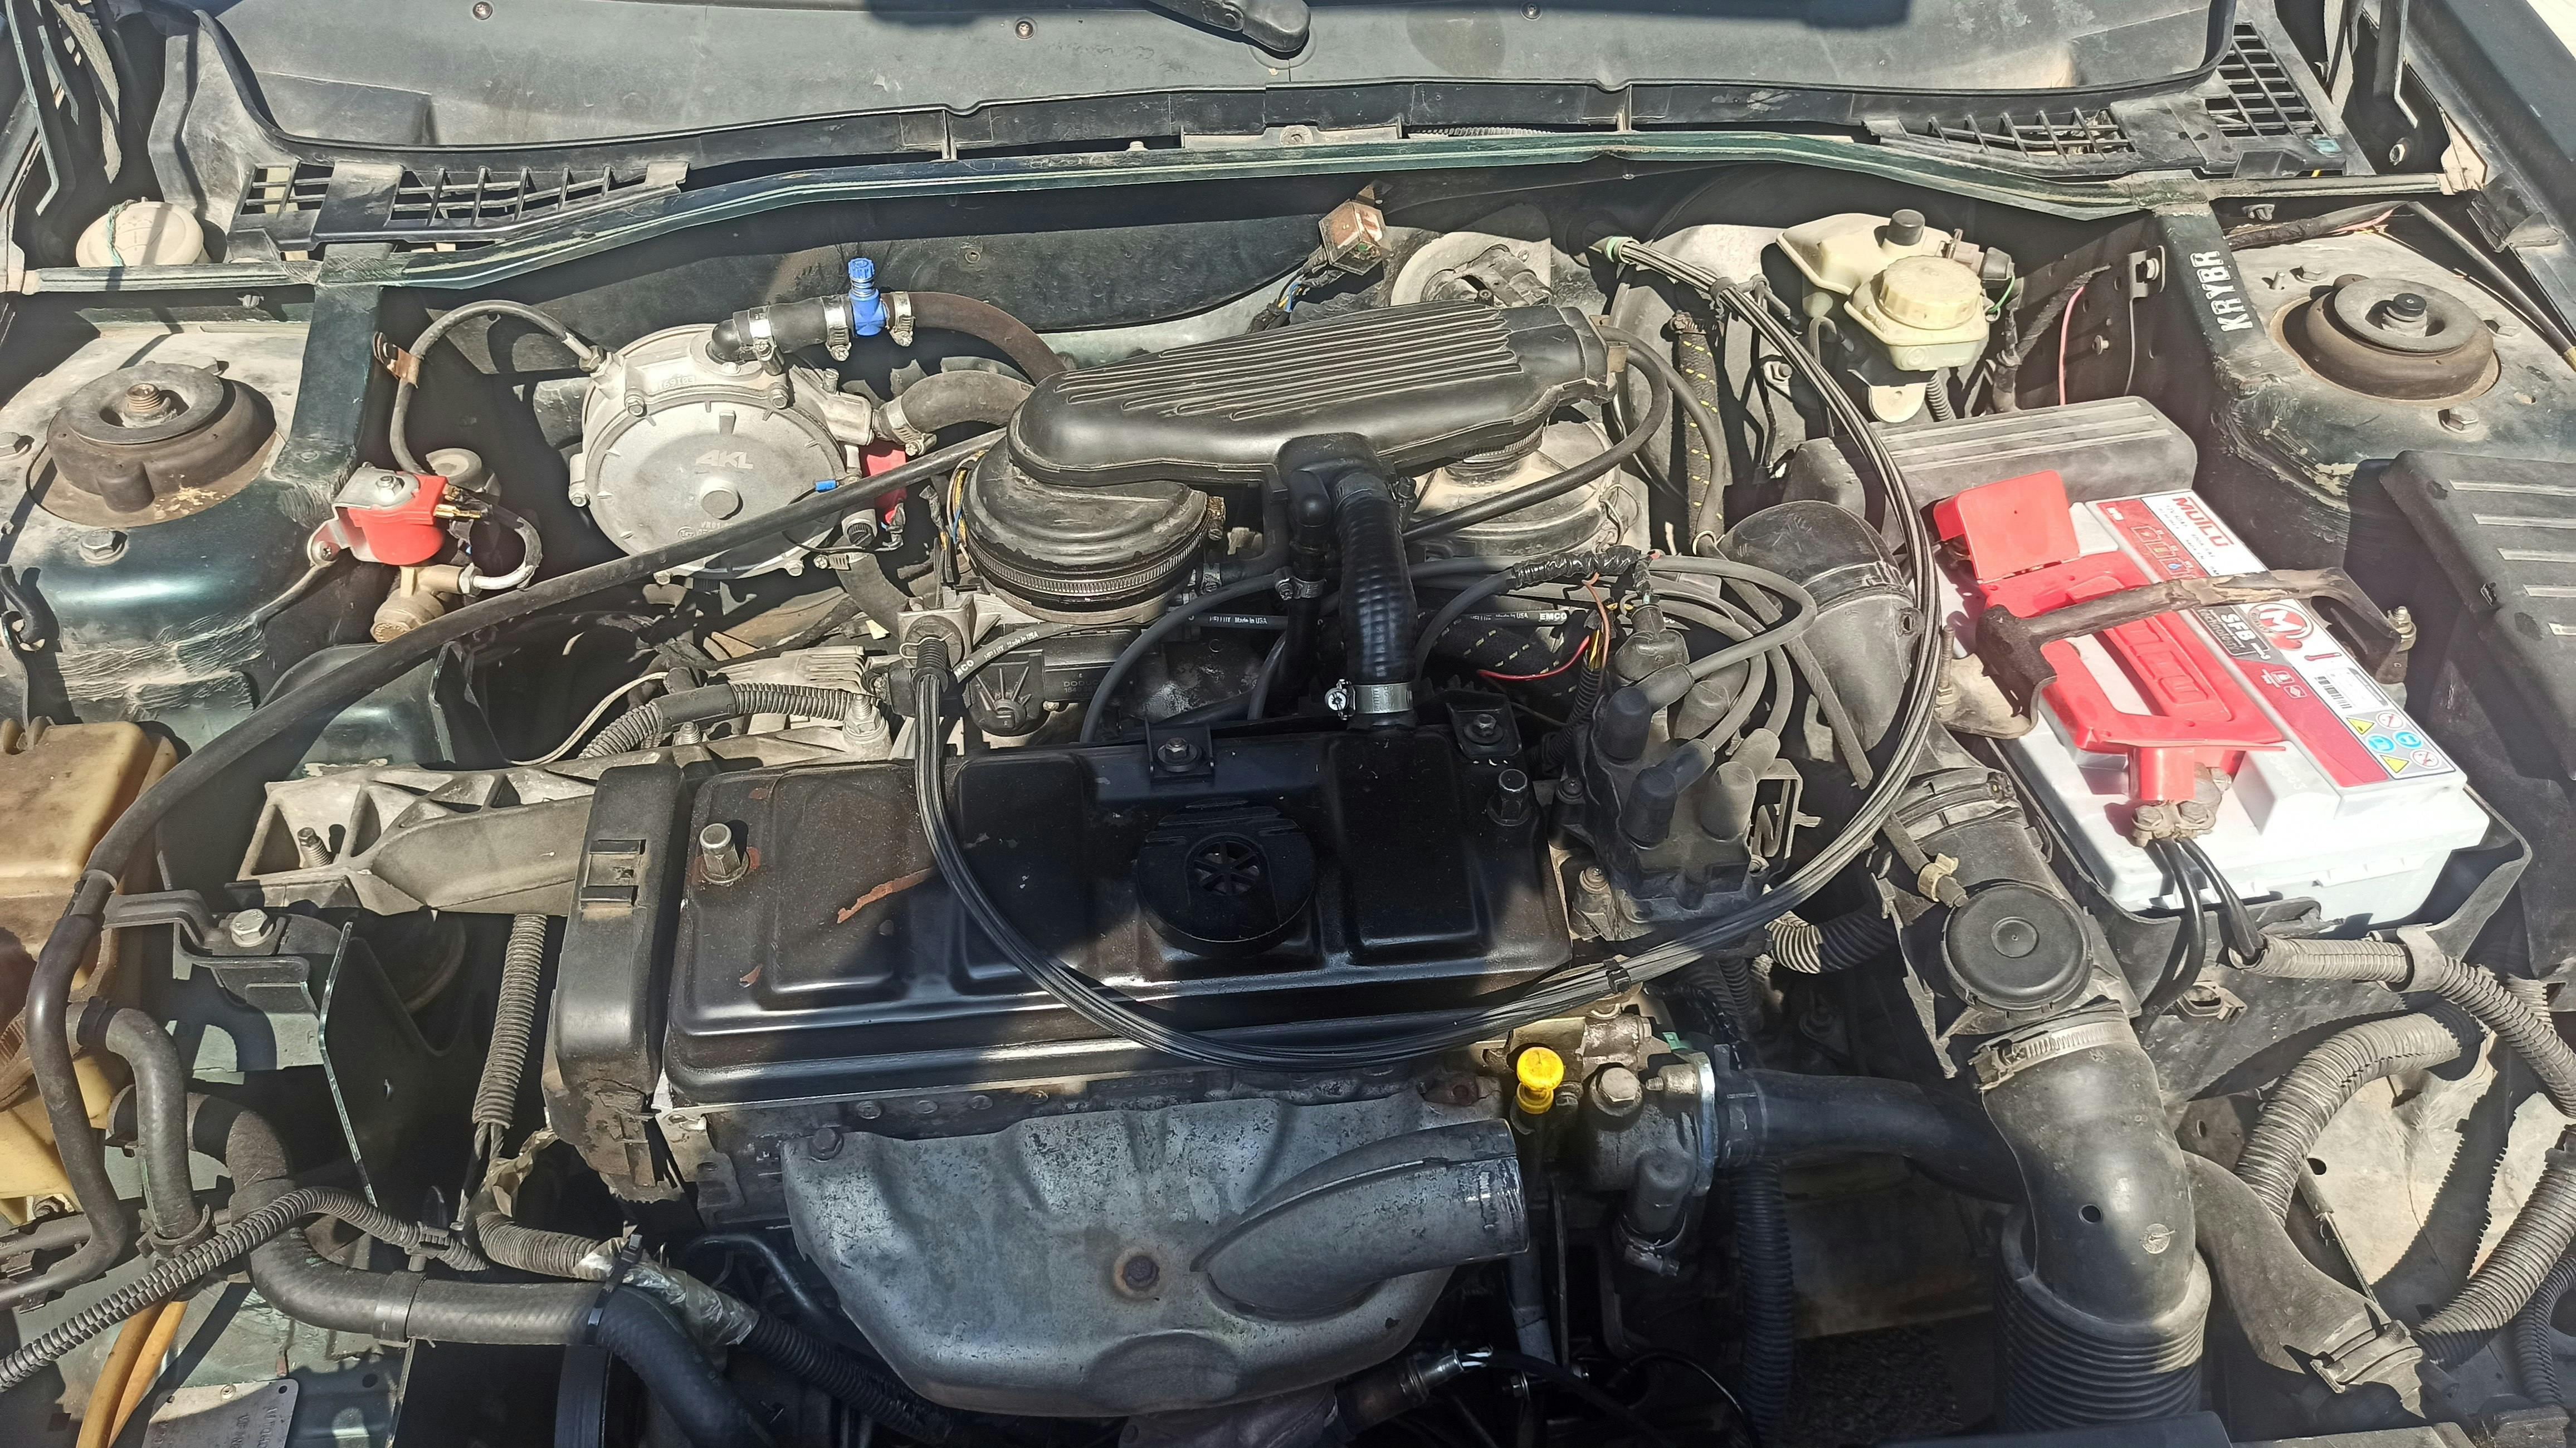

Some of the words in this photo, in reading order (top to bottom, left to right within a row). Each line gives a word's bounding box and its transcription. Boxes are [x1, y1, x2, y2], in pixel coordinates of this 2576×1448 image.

[696, 449, 754, 469] AKL
[2172, 496, 2235, 546] MUTLU
[1539, 612, 1568, 621] EMCO
[2221, 613, 2257, 641] SFB
[953, 659, 974, 678] MCO
[1026, 630, 1039, 640] USA
